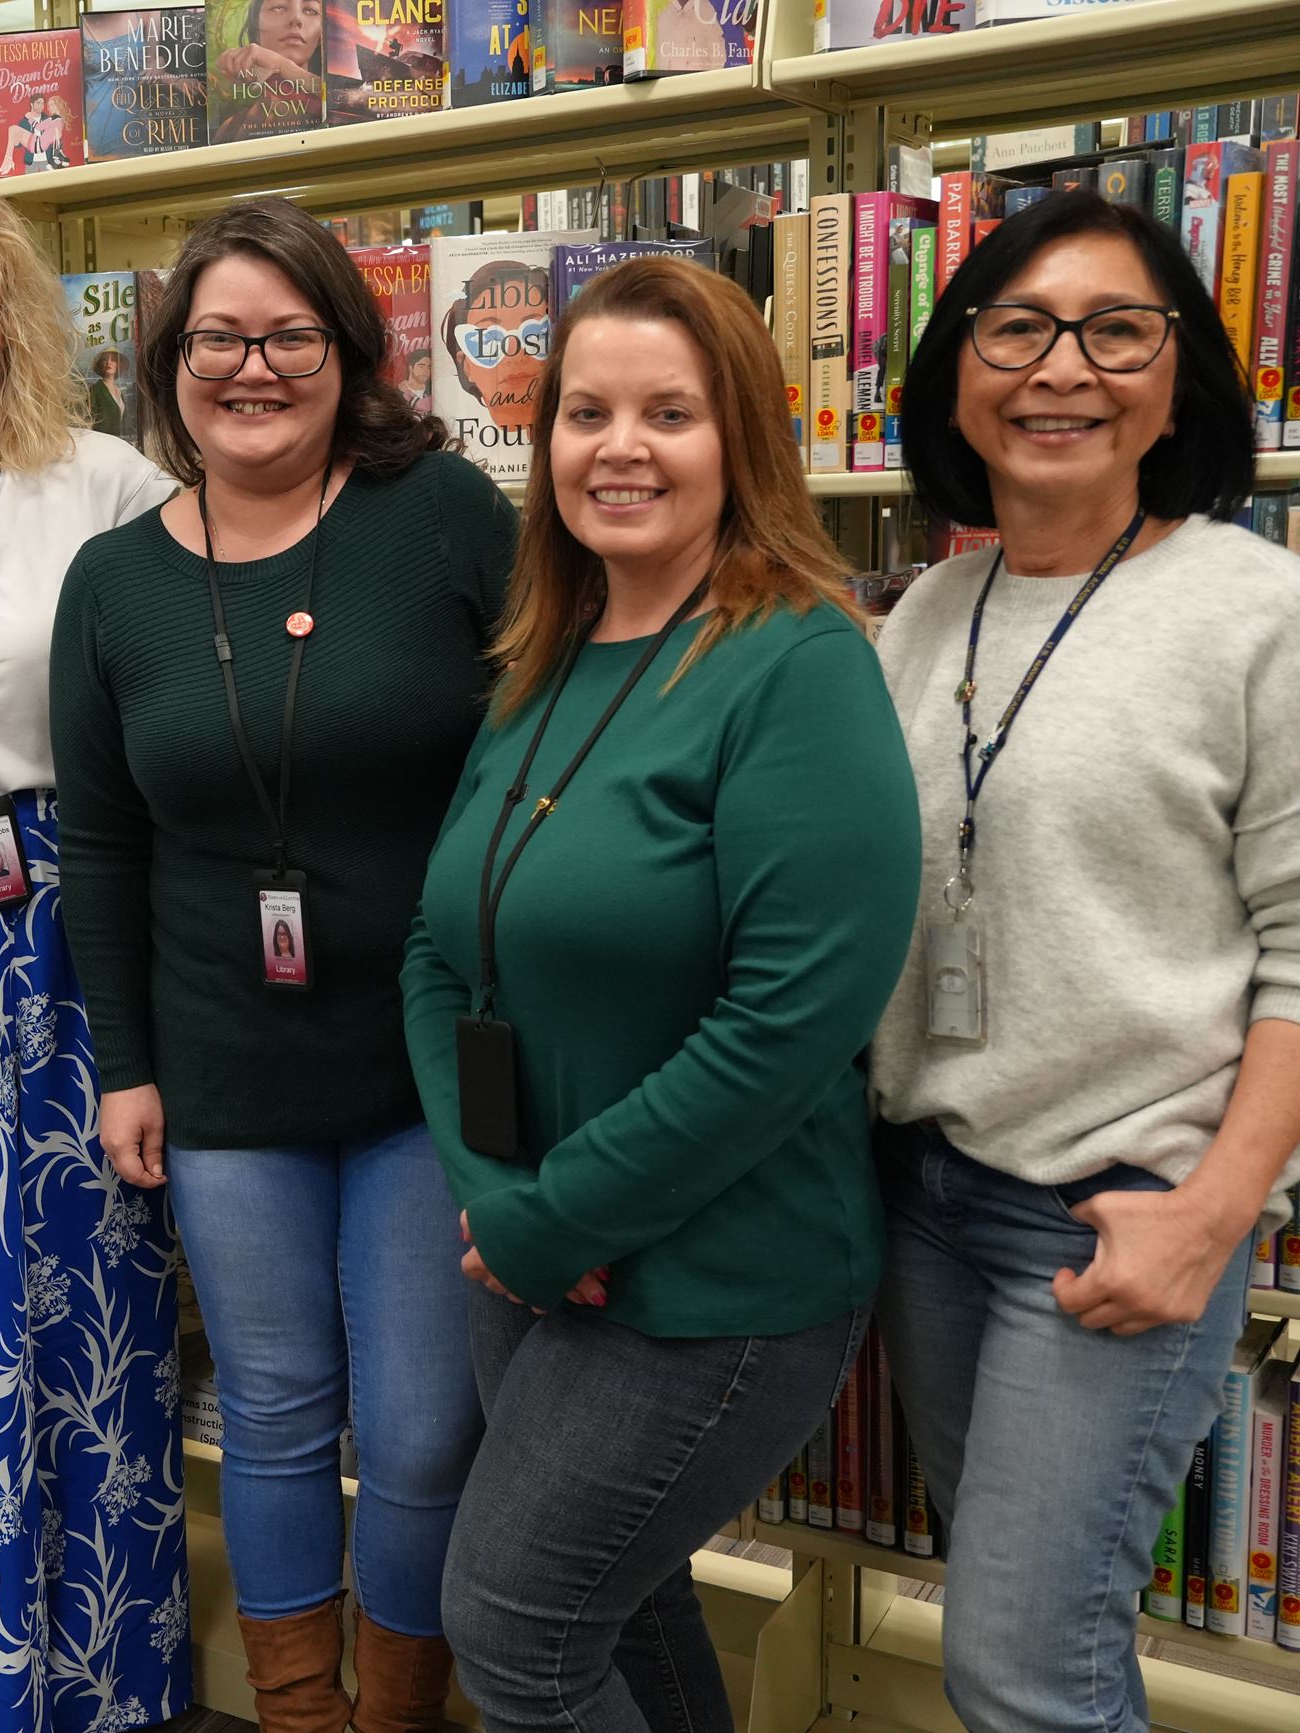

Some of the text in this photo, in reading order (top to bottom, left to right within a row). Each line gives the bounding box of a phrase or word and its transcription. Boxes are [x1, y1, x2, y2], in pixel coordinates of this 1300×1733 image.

[357, 0, 442, 26] CLANC
[579, 8, 623, 35] NE
[127, 15, 192, 42] MARIE
[489, 24, 511, 56] AT
[32, 40, 69, 60] BAILEY
[100, 42, 206, 72] BENEDIC
[660, 41, 755, 58] Charles B. Fanc
[42, 59, 71, 81] Girl
[238, 68, 254, 78] AN
[10, 82, 60, 104] Drama
[112, 82, 208, 114] QUEENS
[374, 78, 444, 92] DEFENSE
[491, 82, 529, 96] ELIZABE
[261, 99, 310, 118] VOW
[368, 95, 444, 109] PROTOCO
[123, 117, 200, 146] CRIME
[992, 140, 1068, 158] Ann Patchett
[948, 182, 962, 212] PAT
[420, 213, 452, 228] KOONTZ
[859, 212, 875, 244] MIGHT
[1266, 154, 1290, 286] THE MOST CRIME
[566, 255, 589, 266] ALI
[858, 261, 874, 272] IN
[859, 246, 874, 260] BE
[915, 234, 932, 289] Change
[411, 264, 431, 294] BA
[783, 252, 797, 306] QUEEN'S
[816, 206, 838, 331] CONFESSIONS
[82, 280, 134, 317] Sile
[460, 274, 545, 310] Libb
[858, 275, 874, 320] TROUBLE
[88, 322, 102, 334] as
[786, 312, 797, 348] COOK
[858, 331, 872, 410] DANIEL ALEMAN
[490, 378, 539, 407] and
[490, 464, 528, 474] HANIE
[264, 904, 296, 914] Krista Berg
[276, 965, 296, 975] Library
[1194, 1448, 1205, 1490] MONEY
[1258, 1422, 1273, 1546] MURDER DRESSING ROOM
[1164, 1528, 1178, 1564] SARA
[1283, 1532, 1298, 1558] KIKI
